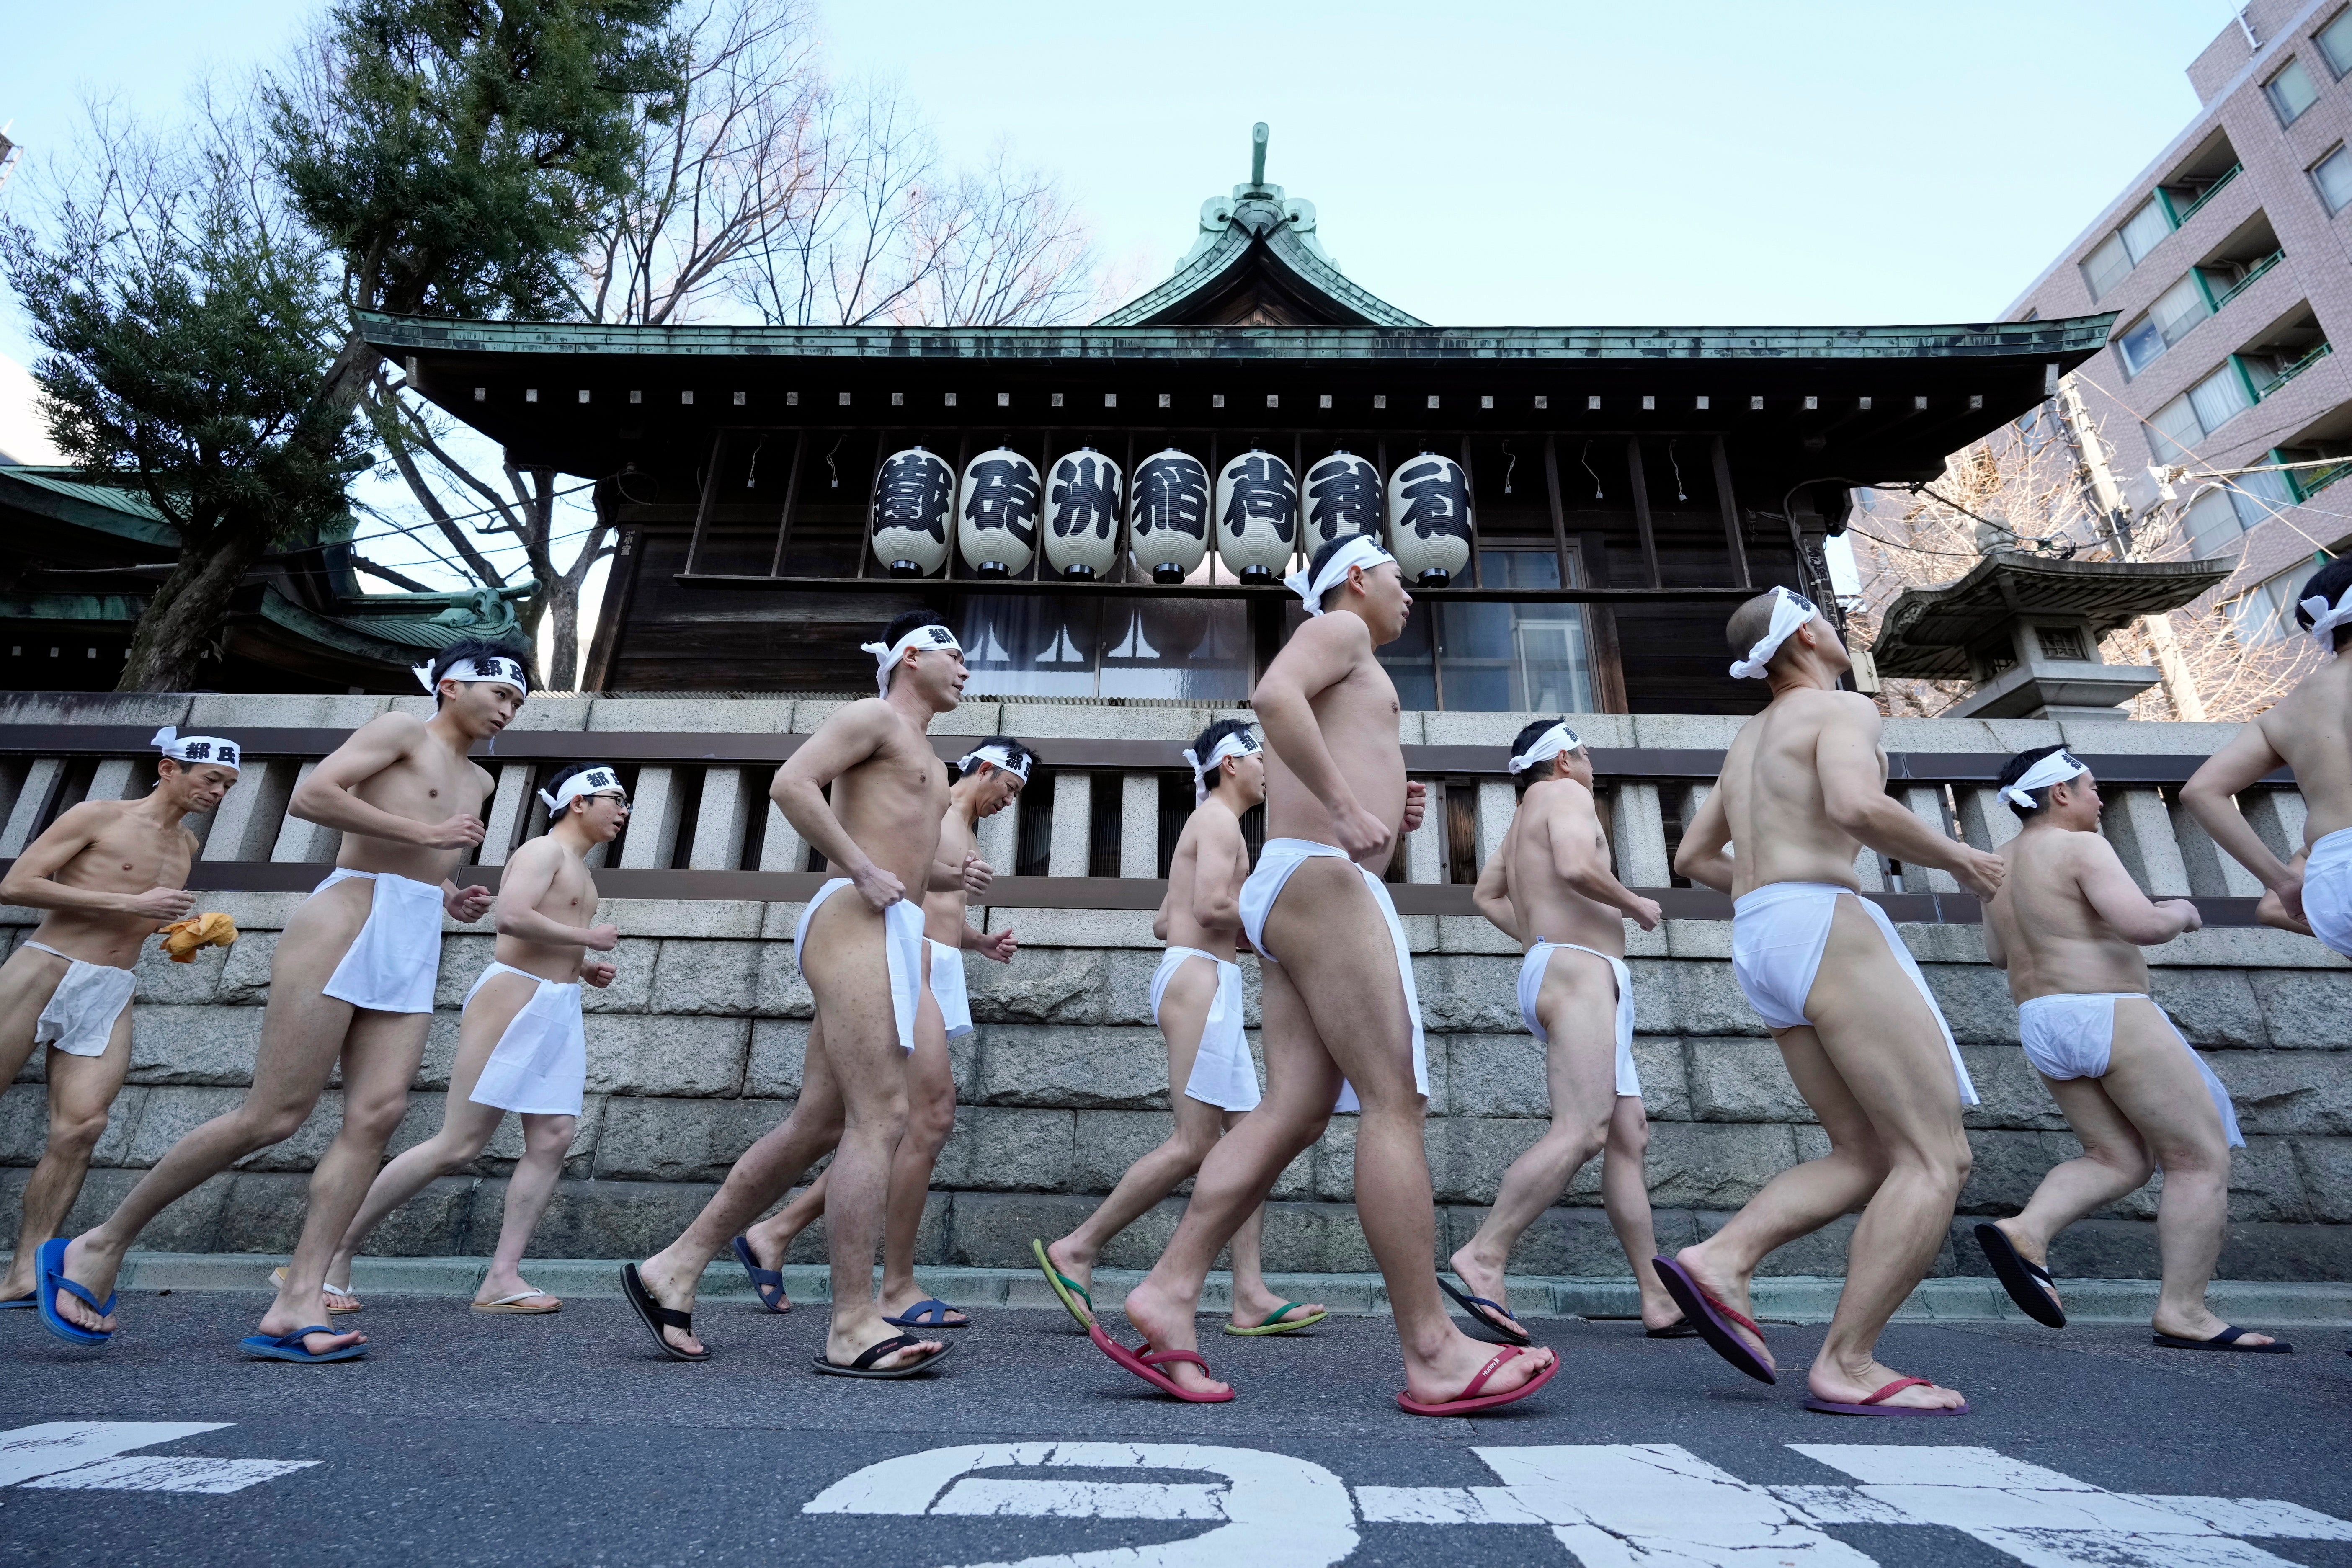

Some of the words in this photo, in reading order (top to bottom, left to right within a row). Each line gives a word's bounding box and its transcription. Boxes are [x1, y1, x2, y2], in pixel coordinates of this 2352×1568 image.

[928, 628, 954, 644] 都
[185, 742, 241, 769] 都民
[1482, 1361, 1497, 1377] Hurley
